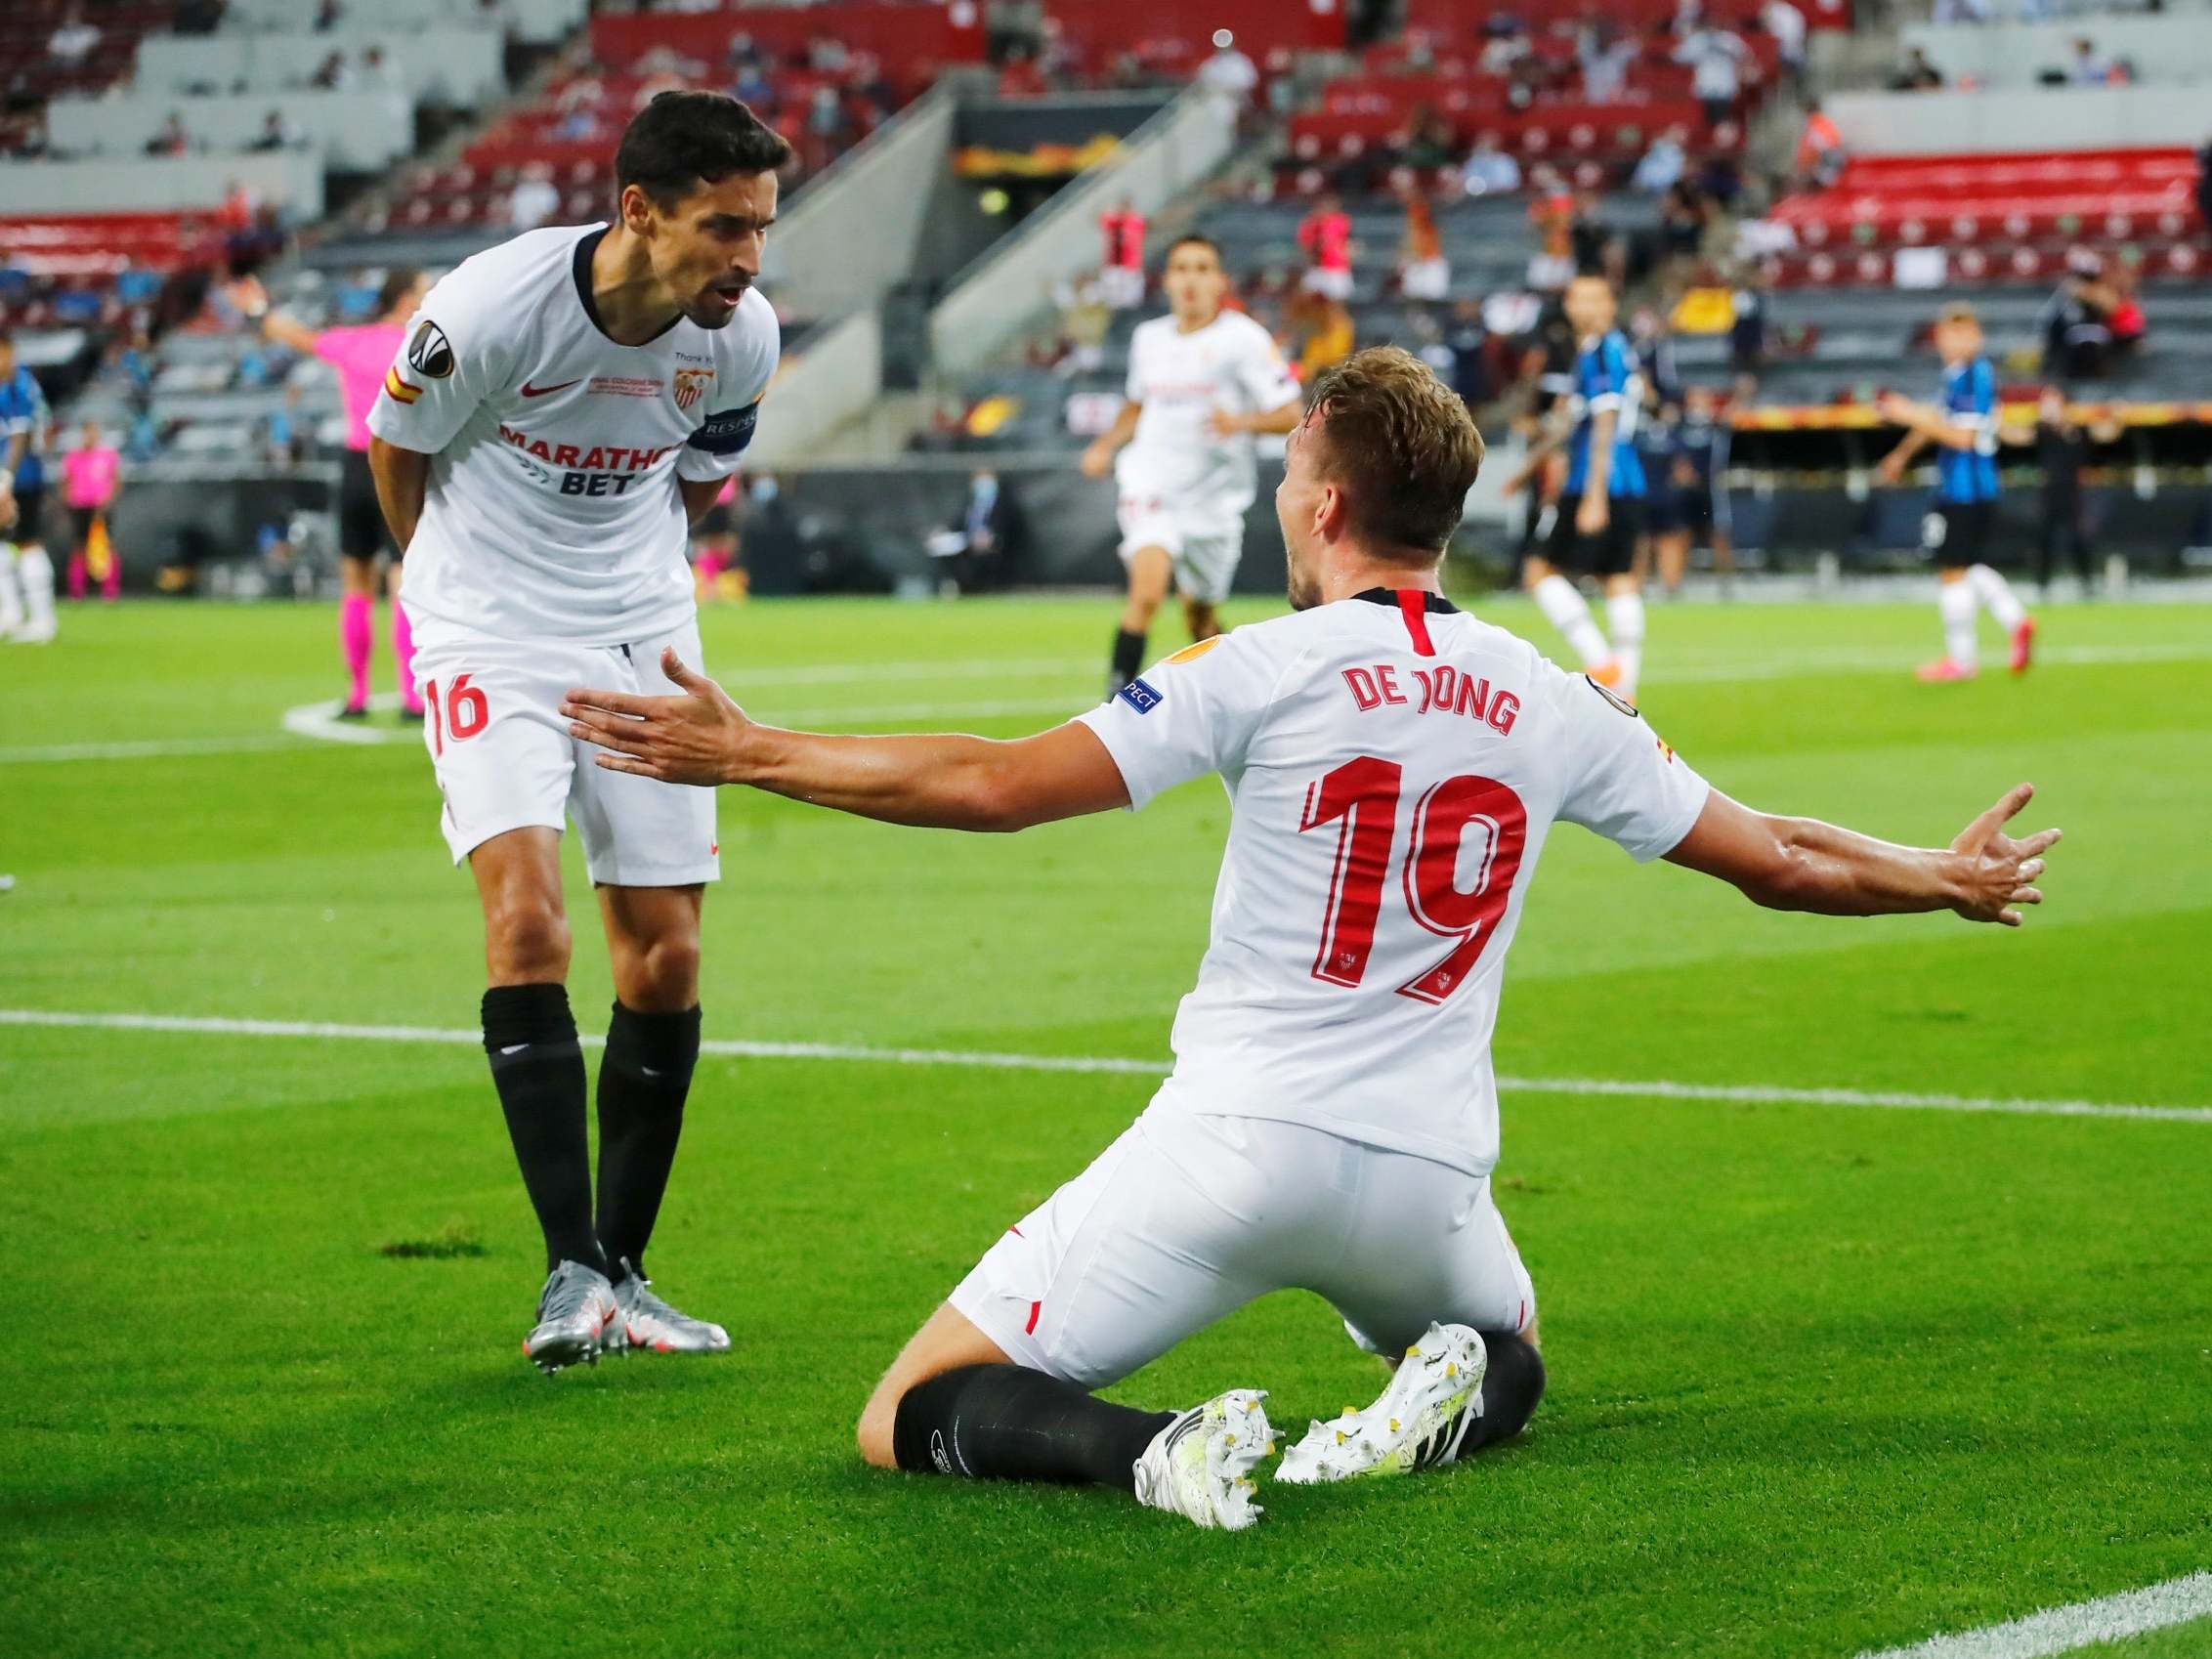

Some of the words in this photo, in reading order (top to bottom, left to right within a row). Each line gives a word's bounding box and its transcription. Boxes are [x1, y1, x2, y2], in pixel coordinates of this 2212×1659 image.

[560, 472, 636, 496] BET
[426, 673, 489, 758] 16
[1341, 664, 1408, 712] DE
[1411, 664, 1521, 737] JONG
[1298, 755, 1528, 1006] 19
